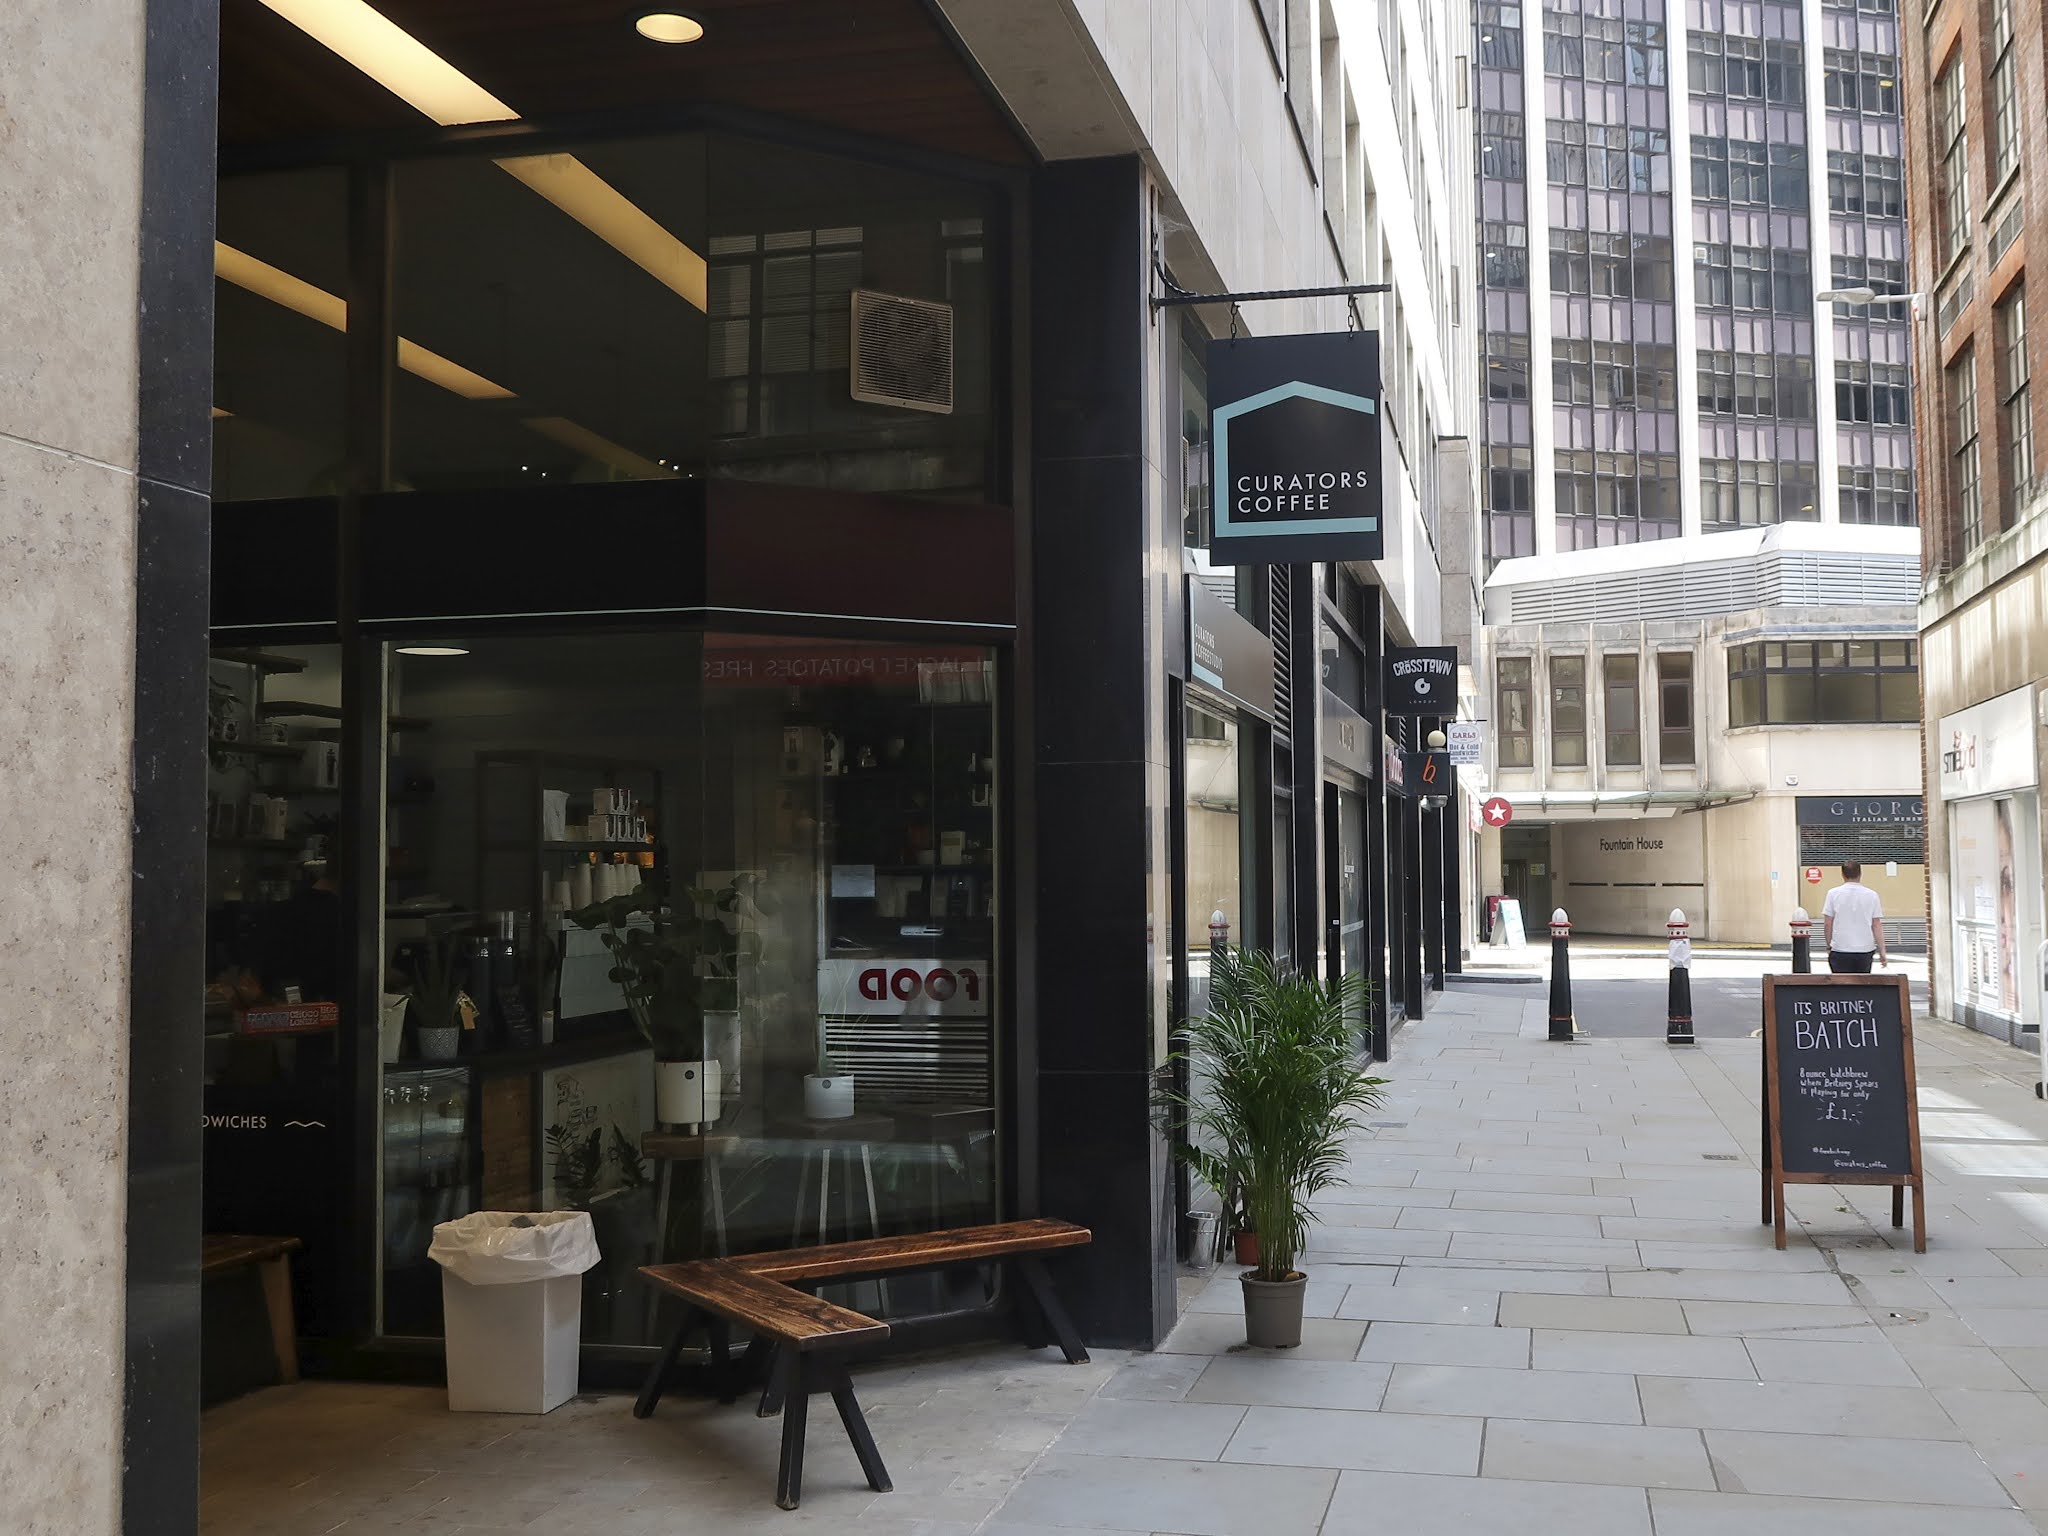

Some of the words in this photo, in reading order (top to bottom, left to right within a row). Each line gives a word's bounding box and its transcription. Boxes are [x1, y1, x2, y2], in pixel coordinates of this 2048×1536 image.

[1237, 470, 1368, 493] CURATORS
[1237, 493, 1330, 514] COFFEE
[1195, 623, 1215, 649] CURATORS
[1392, 658, 1453, 677] CROSSTOWN
[1600, 837, 1634, 851] Fountain
[1636, 837, 1664, 850] House
[1794, 1002, 1812, 1015] ITS
[1819, 1000, 1874, 1015] BRITNEY
[1795, 1018, 1879, 1050] BATCH
[1800, 1078, 1822, 1086] when
[1824, 1078, 1852, 1090] Britney
[1854, 1080, 1879, 1090] Spears
[1800, 1087, 1807, 1095] is
[1810, 1087, 1838, 1099] playing
[1840, 1090, 1850, 1098] for
[1853, 1090, 1870, 1101] only
